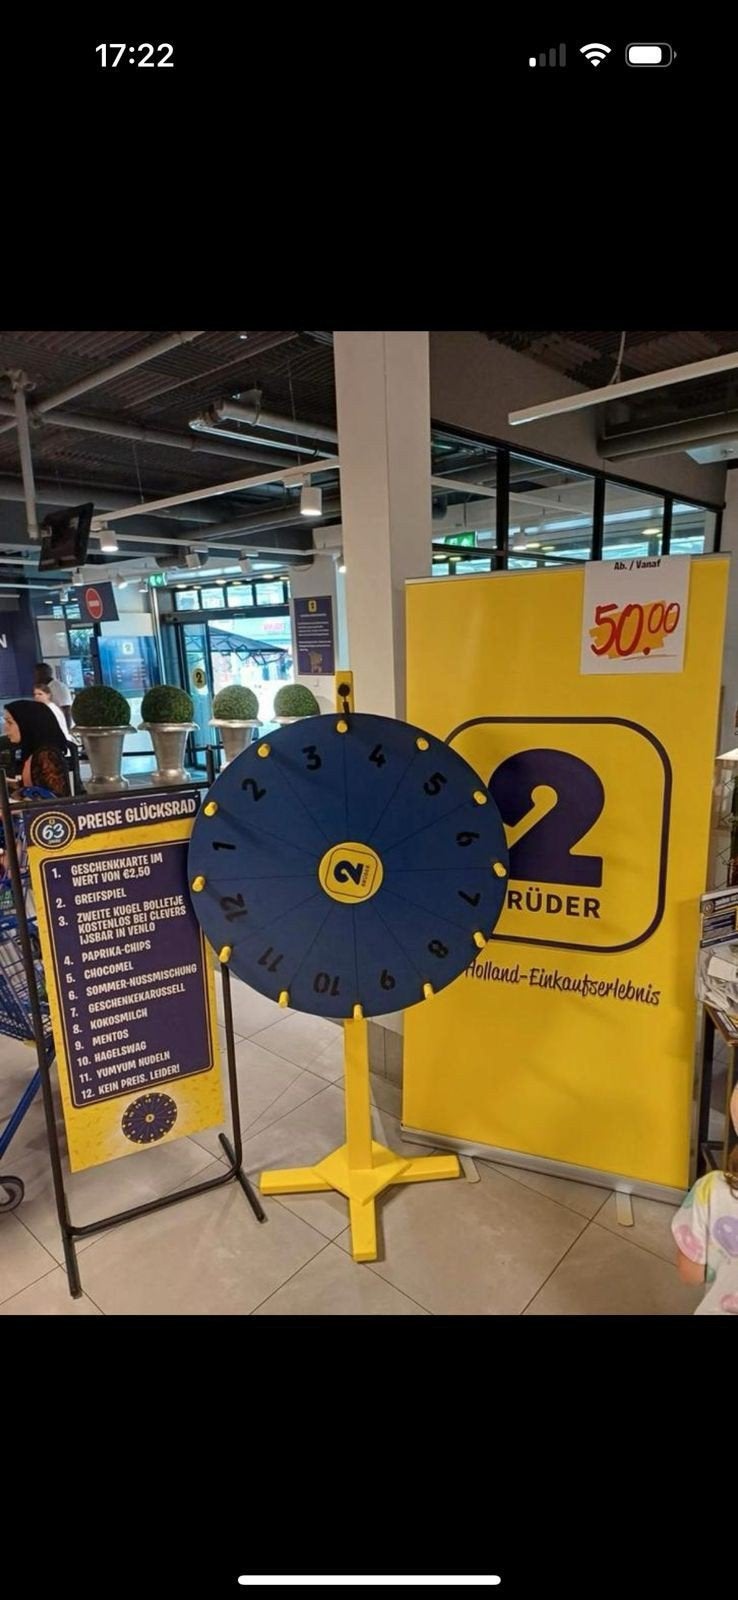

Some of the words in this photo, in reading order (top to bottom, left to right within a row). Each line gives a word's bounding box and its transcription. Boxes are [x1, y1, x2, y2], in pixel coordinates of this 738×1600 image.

[614, 561, 627, 571] Ab.
[636, 559, 661, 569] Vanaf
[590, 602, 681, 656] 50.00
[303, 745, 322, 770] 3
[368, 744, 386, 768] 4
[241, 778, 267, 801] 2
[423, 772, 447, 796] 5
[78, 811, 122, 830] PREISE
[125, 799, 196, 825] GLÜCKSRAD
[487, 748, 605, 888] 2
[42, 823, 64, 840] 63
[455, 831, 480, 847] 6
[212, 841, 236, 852] 1
[52, 868, 61, 878] 1.
[71, 856, 148, 876] GESCHENKKARTE
[151, 852, 163, 863] IM
[72, 873, 99, 887] WERT
[101, 870, 120, 883] VON
[123, 866, 151, 880] €2,50
[333, 860, 364, 886] 2
[56, 899, 66, 909] 2.
[74, 888, 127, 905] GREIFSPIEL
[59, 916, 69, 926] 3.
[77, 909, 111, 924] ZWEITE
[113, 904, 141, 919] KUGEL
[143, 895, 183, 913] BOLLETJE
[219, 893, 248, 922] 12
[458, 890, 481, 907] 7
[507, 887, 600, 918] RÜDER
[78, 914, 131, 934] KOSTENLOS
[133, 910, 148, 924] BEI
[150, 905, 186, 921] CLEVERS
[80, 929, 114, 945] IJSBAR
[116, 925, 126, 938] IN
[128, 922, 155, 936] VENLO
[64, 955, 74, 966] 4.
[82, 940, 151, 963] PAPRIKA-CHIPS
[257, 947, 284, 973] 11
[427, 939, 449, 959] 8
[66, 973, 76, 983] 5.
[84, 961, 134, 980] CHOCOMEL
[68, 989, 78, 1000] 6.
[86, 963, 197, 997] SOMMER-NUSSMISCHUNG
[313, 973, 340, 996] 10
[464, 958, 660, 1006] Holland-Einkaufserlebnis
[70, 1007, 79, 1018] 7.
[88, 983, 186, 1014] GESCHENKEKARUSSELL
[72, 1023, 83, 1034] 8.
[90, 1007, 148, 1030] KOKOSMILCH
[75, 1040, 84, 1051] 9.
[92, 1029, 129, 1047] MENTOS
[76, 1056, 91, 1067] 10.
[94, 1041, 147, 1063] HAGELSWAG
[79, 1072, 92, 1083] 11.
[96, 1059, 136, 1079] YUMYUM
[138, 1051, 170, 1067] NUDELN
[81, 1088, 95, 1100] 12.
[98, 1081, 119, 1095] KEIN
[121, 1074, 148, 1089] PREIS.
[150, 1063, 180, 1081] LEIDER!
